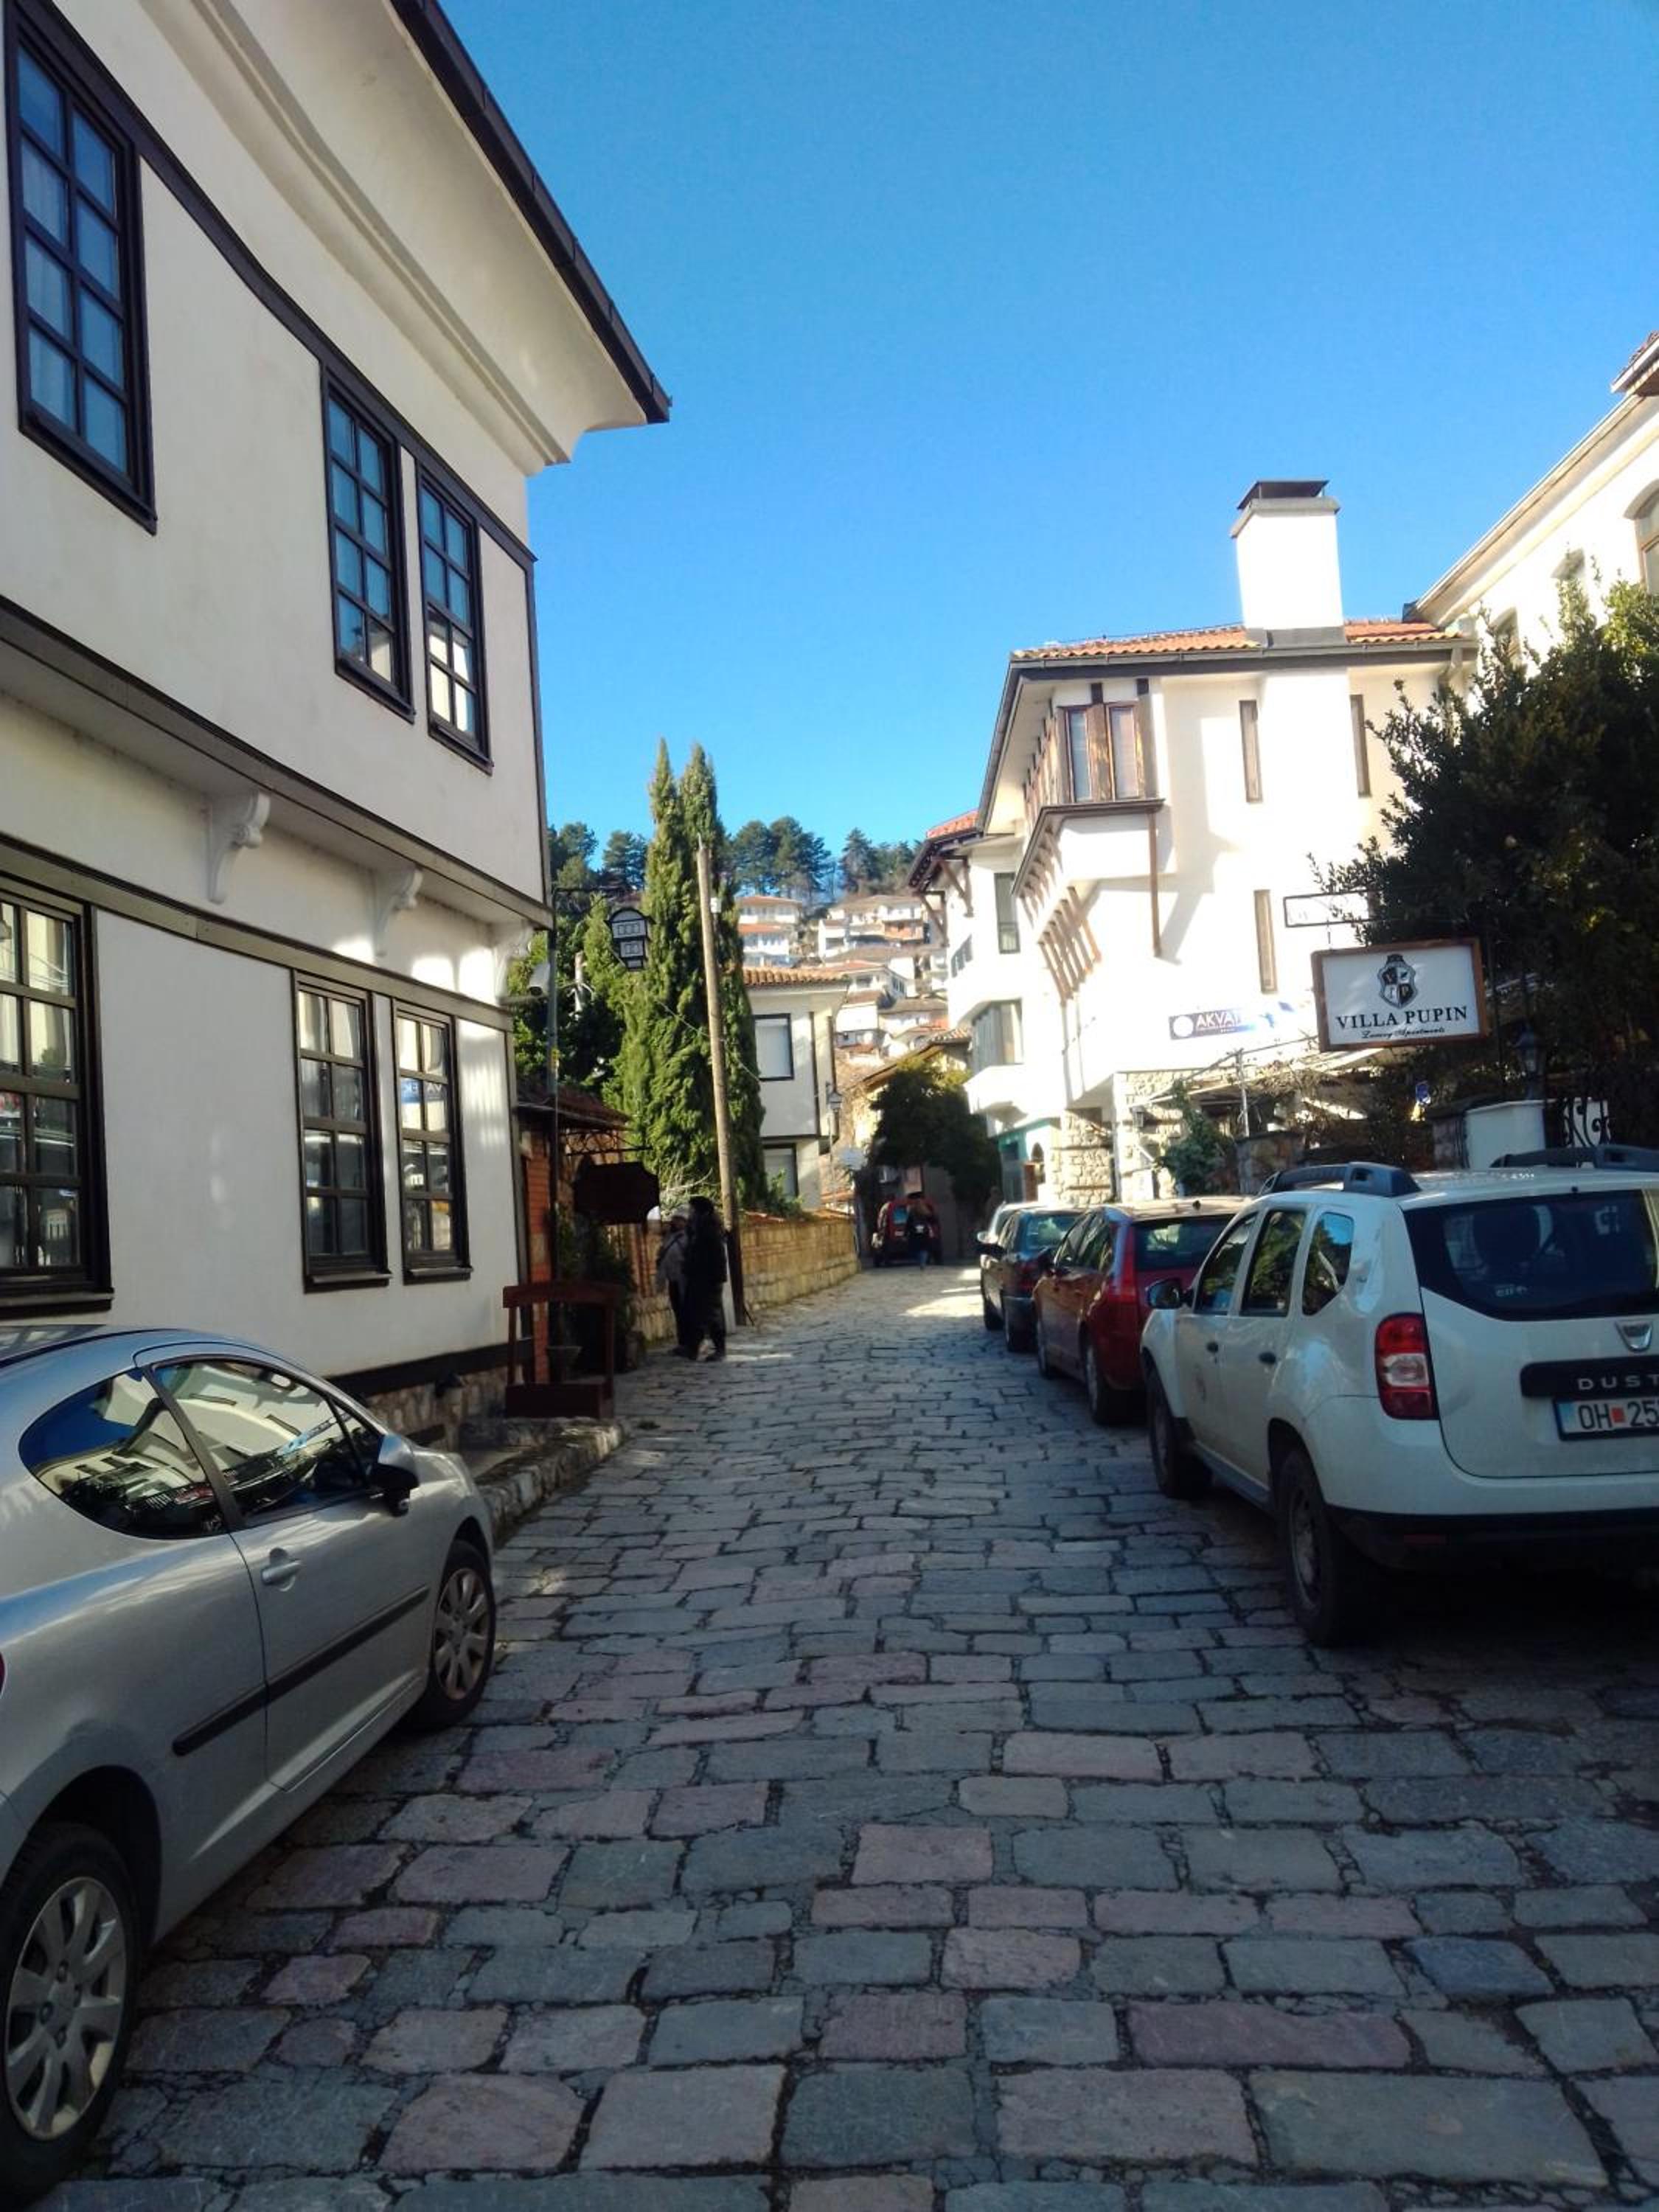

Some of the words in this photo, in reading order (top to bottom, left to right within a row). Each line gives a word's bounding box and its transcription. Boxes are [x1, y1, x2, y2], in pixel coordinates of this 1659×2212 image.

[1336, 1012, 1398, 1029] VILLA
[1405, 1006, 1467, 1024] PUPIN
[1578, 1404, 1613, 1430] OH
